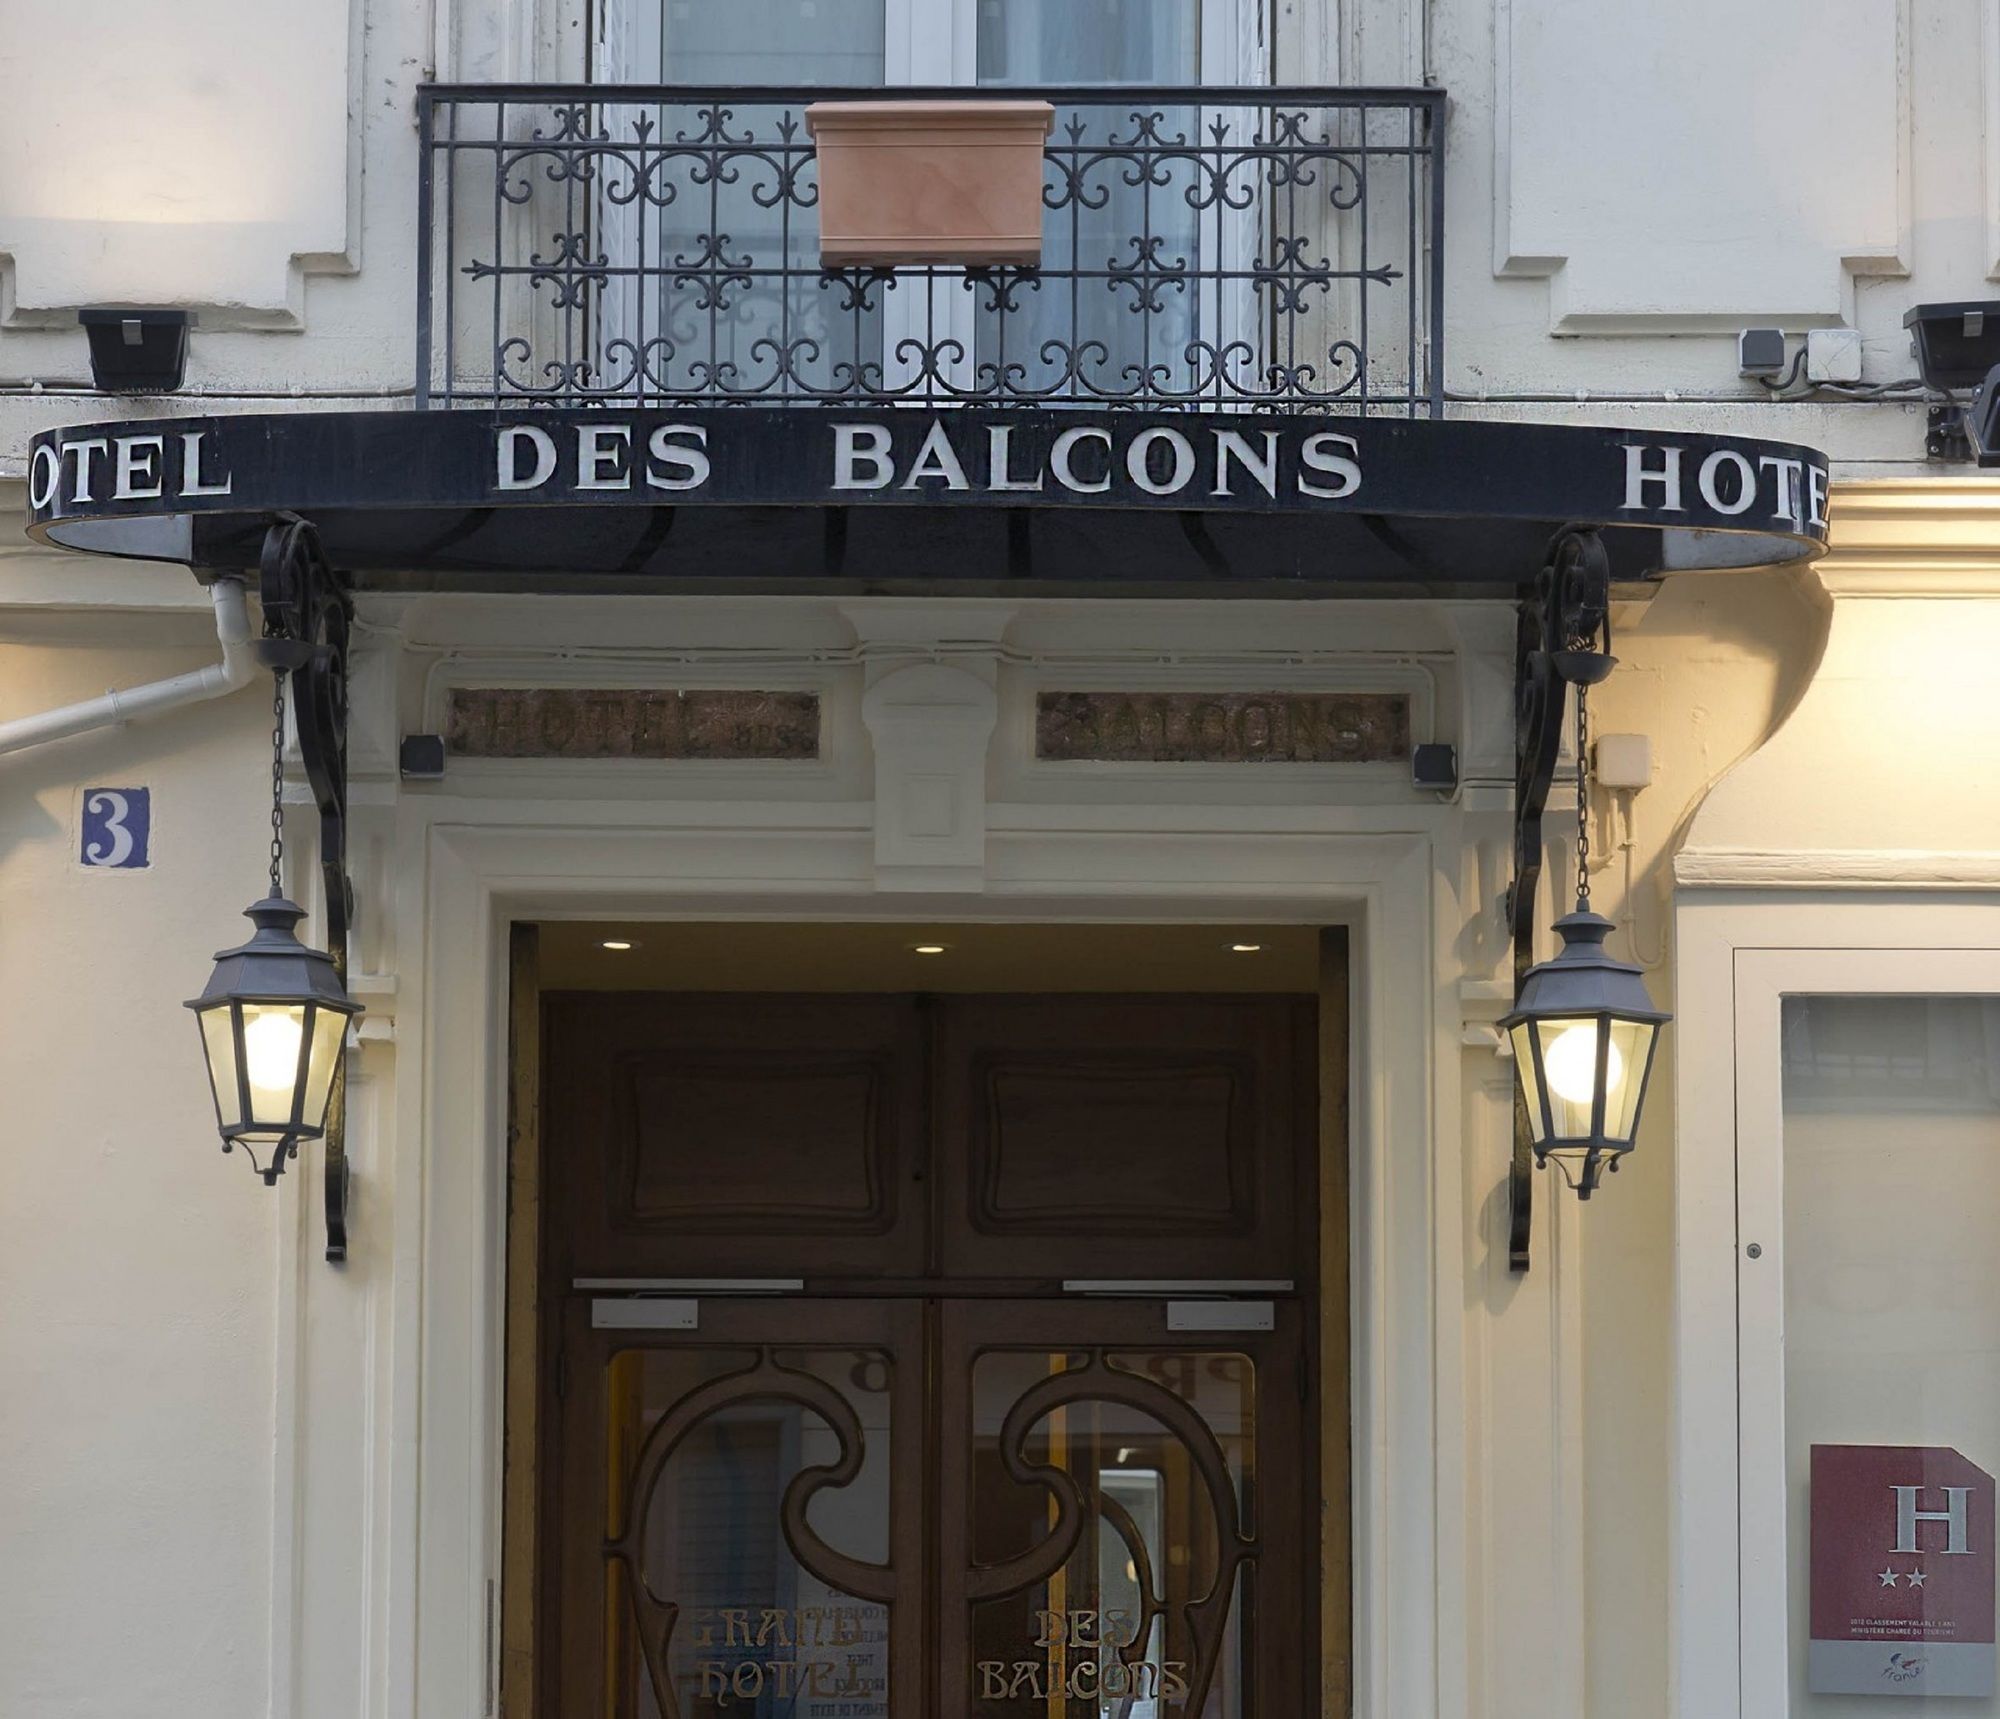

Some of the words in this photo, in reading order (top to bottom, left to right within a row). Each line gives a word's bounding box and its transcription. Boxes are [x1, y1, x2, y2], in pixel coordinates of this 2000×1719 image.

[492, 424, 711, 490] DES
[829, 417, 1363, 499] BALCONS
[86, 791, 134, 867] 3
[1888, 1485, 1977, 1555] H
[1034, 1609, 1131, 1648] DES
